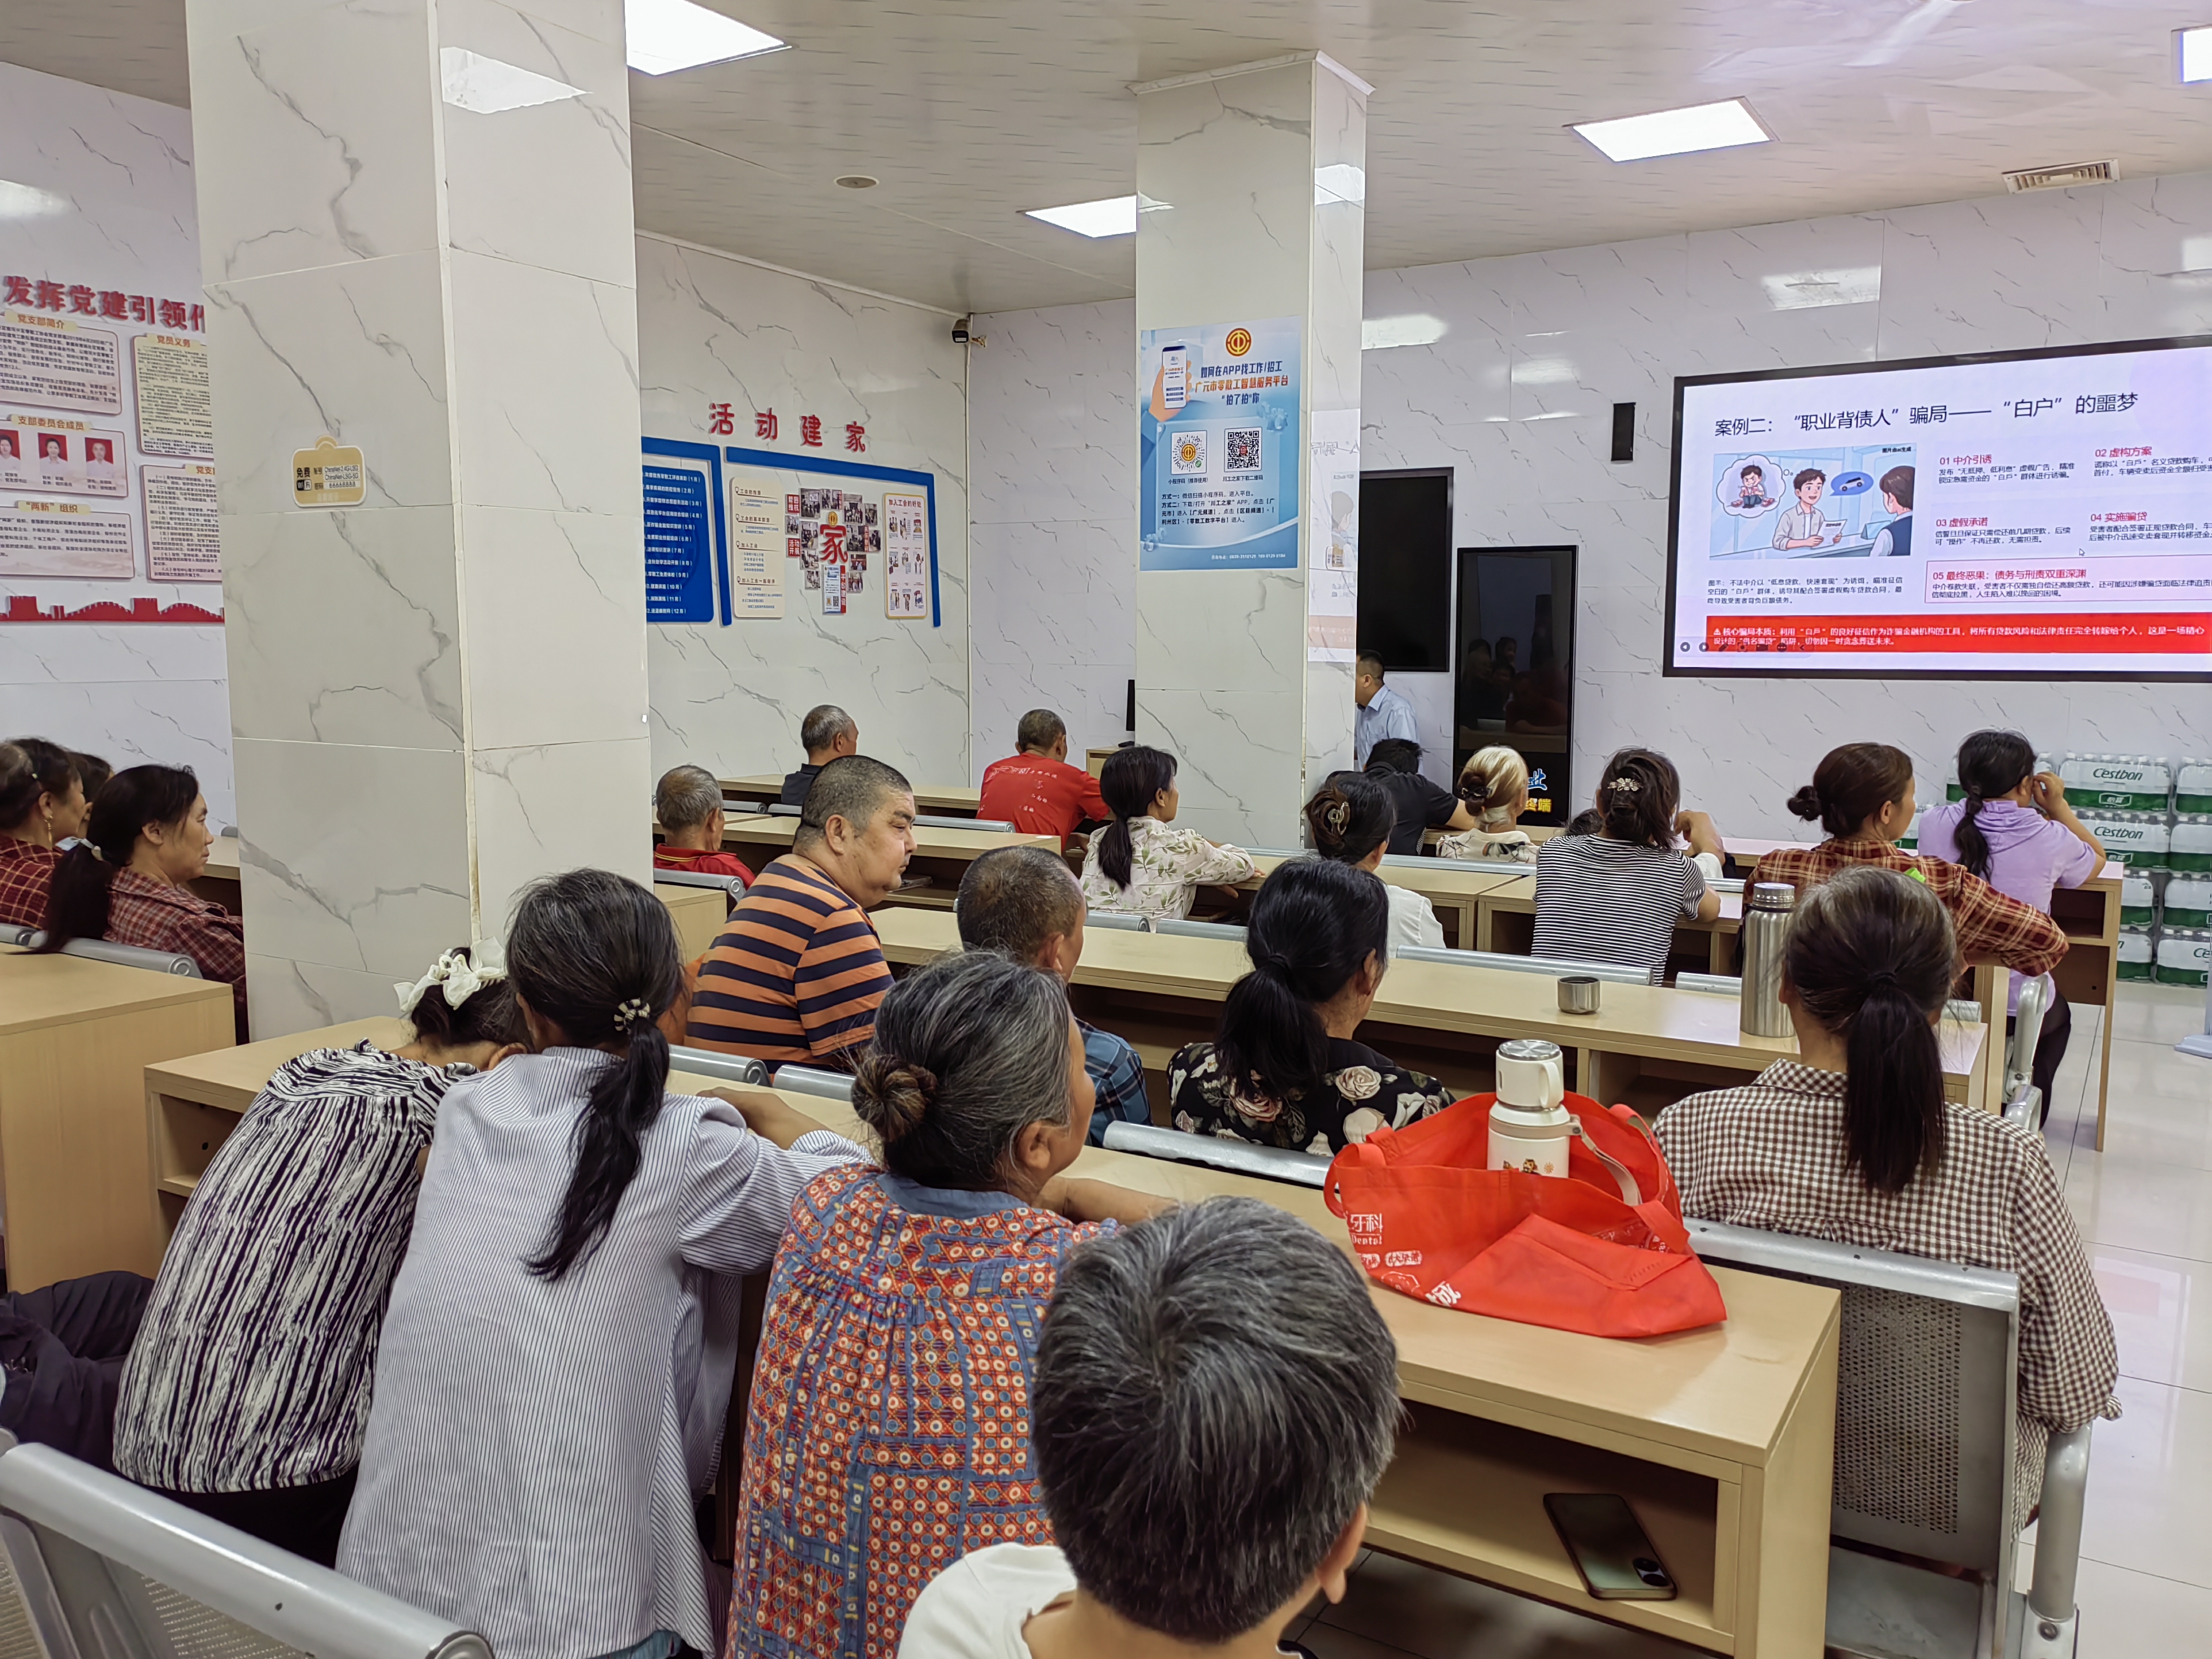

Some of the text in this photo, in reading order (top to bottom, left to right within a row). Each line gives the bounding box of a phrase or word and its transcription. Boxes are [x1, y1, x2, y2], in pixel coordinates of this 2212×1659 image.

[18, 313, 65, 329] 党支部简介
[157, 335, 191, 347] 党员义务
[1201, 361, 1283, 378] 如何在APP找工作/招工
[1195, 375, 1289, 393] 广元市零散工智慧服务平台
[18, 415, 84, 431] 支部委员会成员
[709, 403, 866, 453] 活动建家
[2095, 446, 2152, 457] 02 虚构方案
[1940, 454, 1992, 466] 01 中介引诱
[196, 466, 215, 475] 党支
[297, 467, 311, 478] 免费
[1949, 517, 1988, 528] 虚假承诺
[2090, 511, 2147, 522] 04 实施骗贷
[1933, 572, 1944, 580] 05
[1350, 1213, 1382, 1232] 牙科
